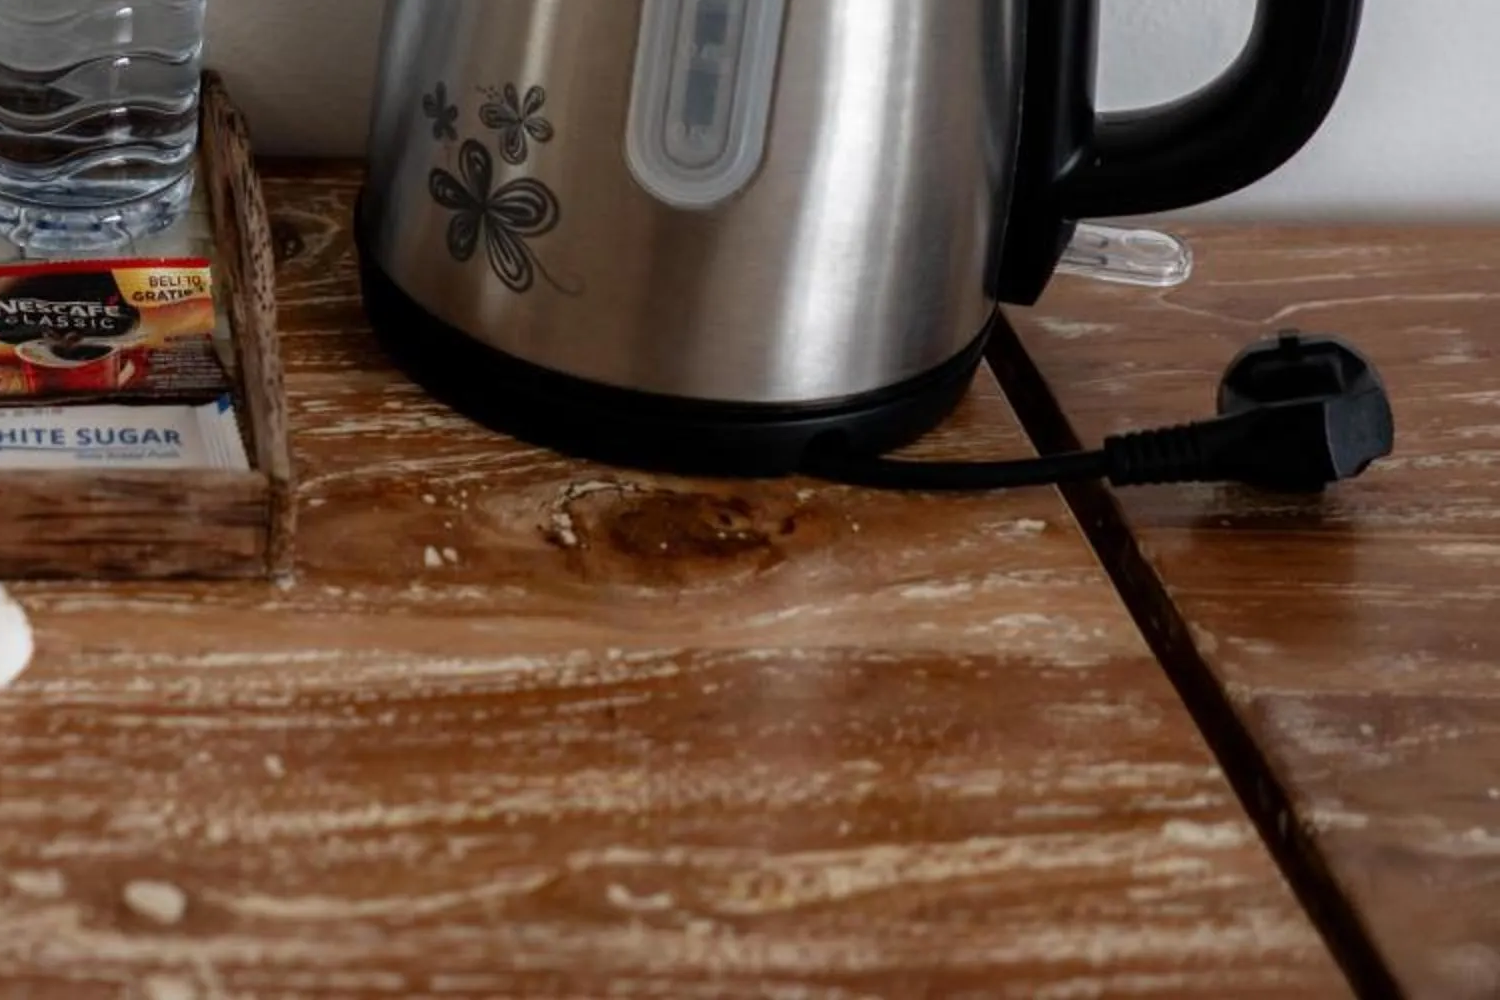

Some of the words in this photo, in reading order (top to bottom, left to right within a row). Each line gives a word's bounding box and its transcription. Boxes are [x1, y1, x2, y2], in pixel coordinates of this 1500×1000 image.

[149, 275, 181, 288] BELI
[5, 313, 116, 330] CLASSIC
[76, 426, 182, 446] SUGAR
